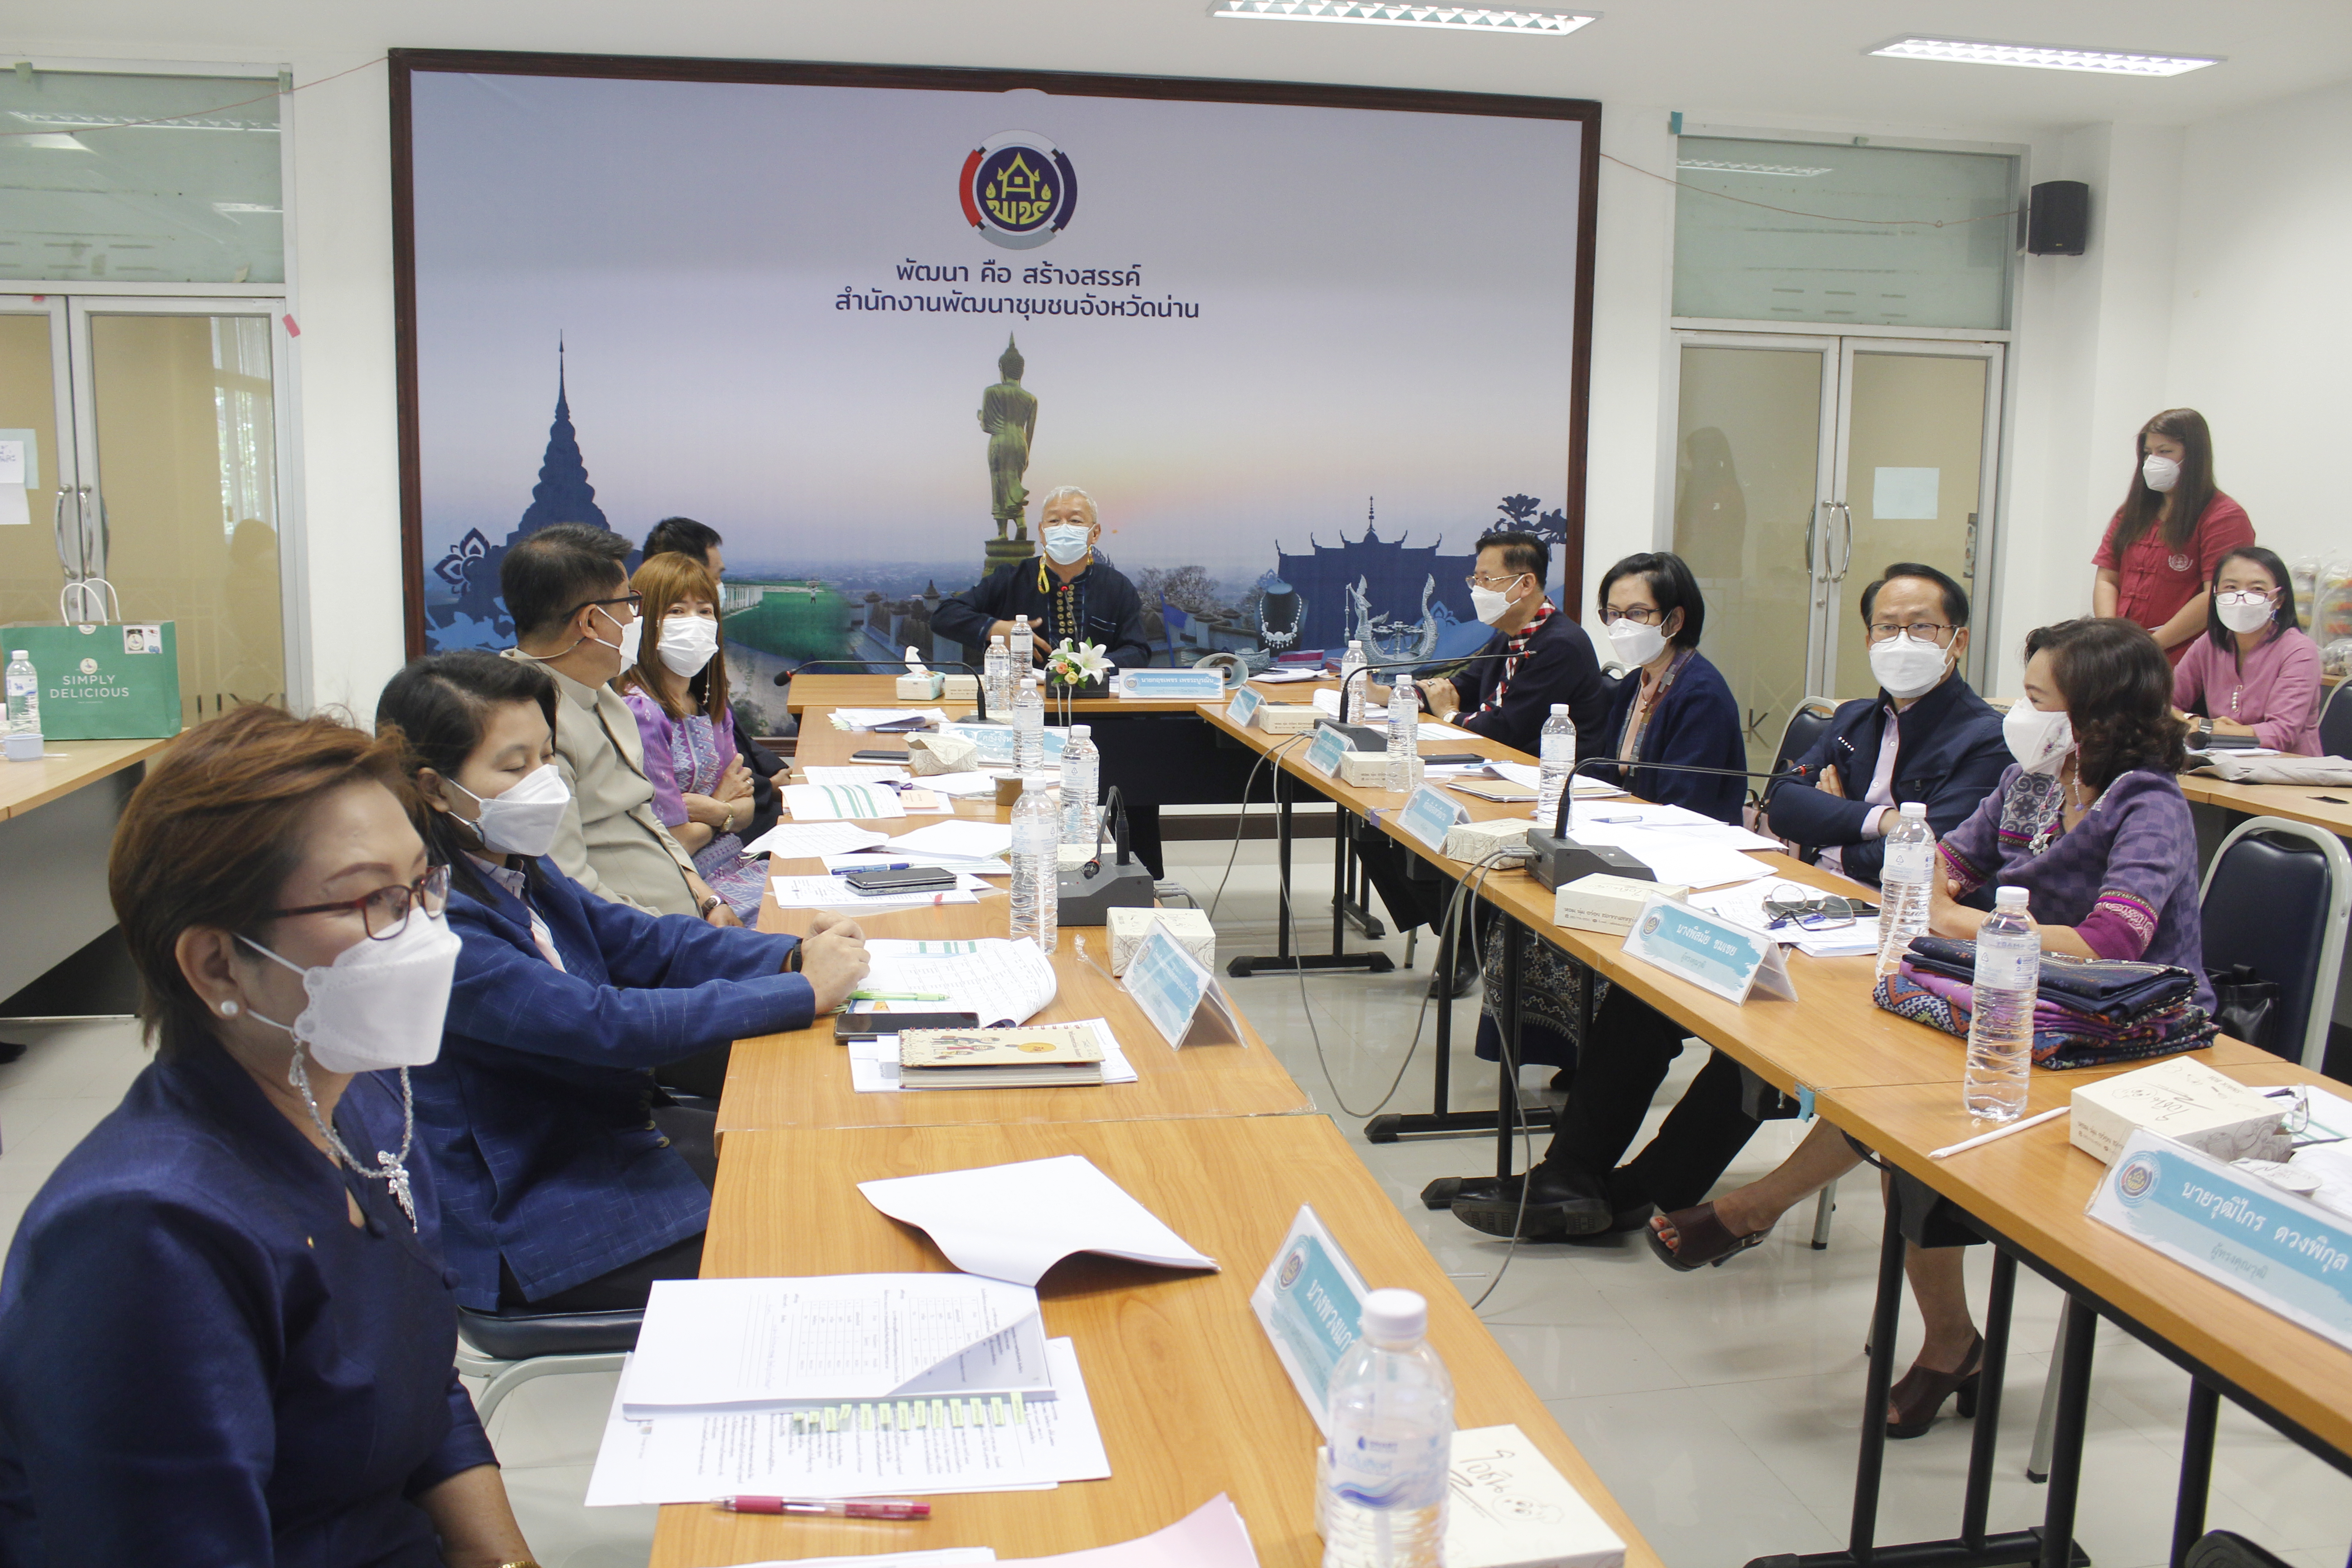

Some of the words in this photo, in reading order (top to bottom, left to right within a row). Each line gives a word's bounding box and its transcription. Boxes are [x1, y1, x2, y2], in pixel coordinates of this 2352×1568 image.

[896, 259, 968, 283] พัฒนา
[981, 260, 1011, 284] คือ
[1023, 261, 1141, 287] สร้างสรรค์
[835, 286, 1199, 321] สำนักงานพัฒนาชุมชนจังหวัดน่าน
[50, 687, 129, 698] DELICIOUS
[63, 675, 115, 685] SIMPLY
[1676, 922, 1710, 946] นางพิสมัย
[1714, 939, 1738, 956] ชมเชย
[2181, 1181, 2266, 1232] นายวุฒิไกร
[2274, 1226, 2350, 1273] ดวงพิกุล
